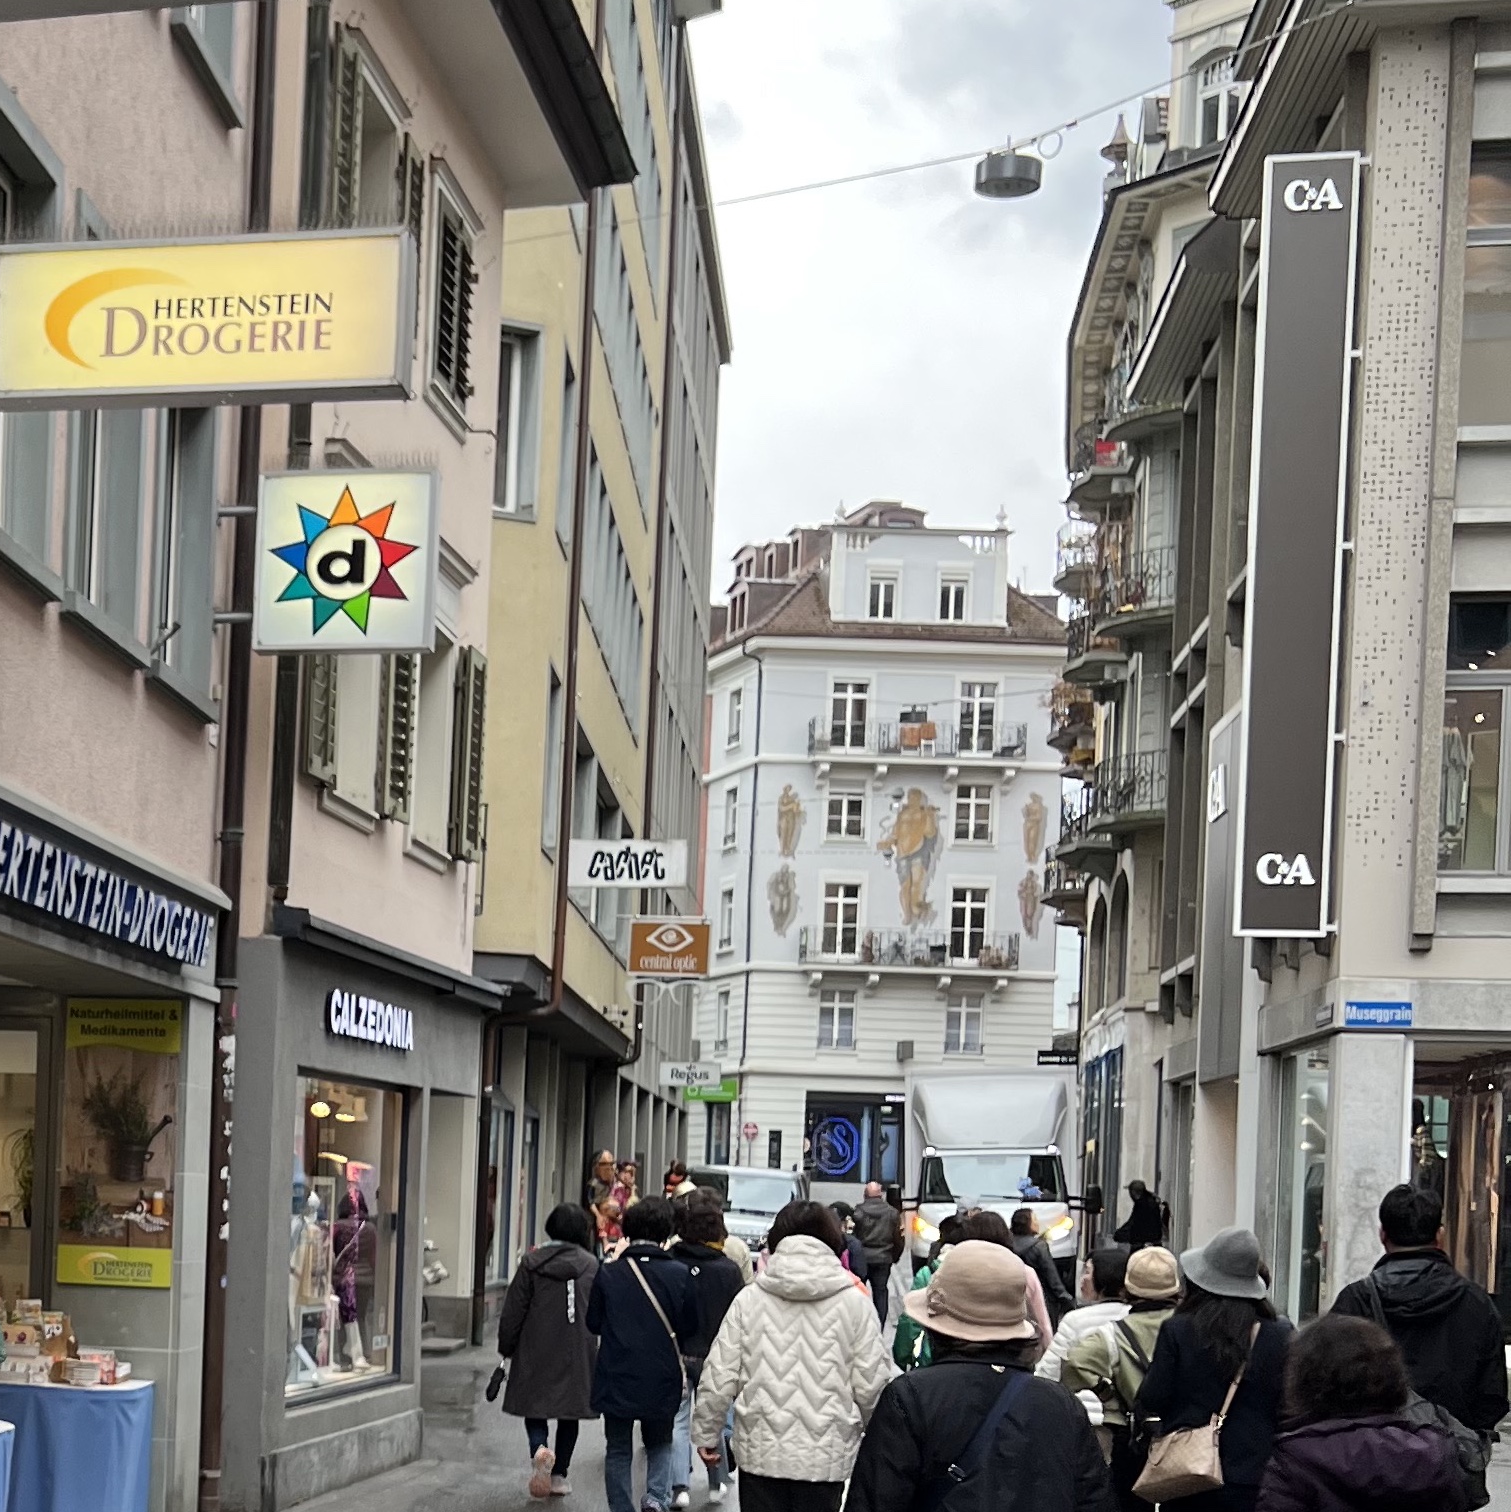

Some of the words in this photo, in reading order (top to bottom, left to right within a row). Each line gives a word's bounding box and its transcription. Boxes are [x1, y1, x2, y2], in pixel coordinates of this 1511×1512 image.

[1283, 178, 1343, 212] C&A
[153, 292, 333, 320] HERTENSTEIN
[99, 305, 332, 358] DROGERIE
[588, 846, 666, 881] cachet
[1256, 853, 1316, 885] C&A
[640, 954, 672, 970] central
[673, 955, 698, 973] optic
[69, 1007, 166, 1020] Naturheilmittel
[330, 988, 414, 1051] CALZEDONIA
[80, 1024, 166, 1037] Medikamente
[671, 1068, 709, 1085] Regus
[93, 1261, 152, 1278] DROGERIE
